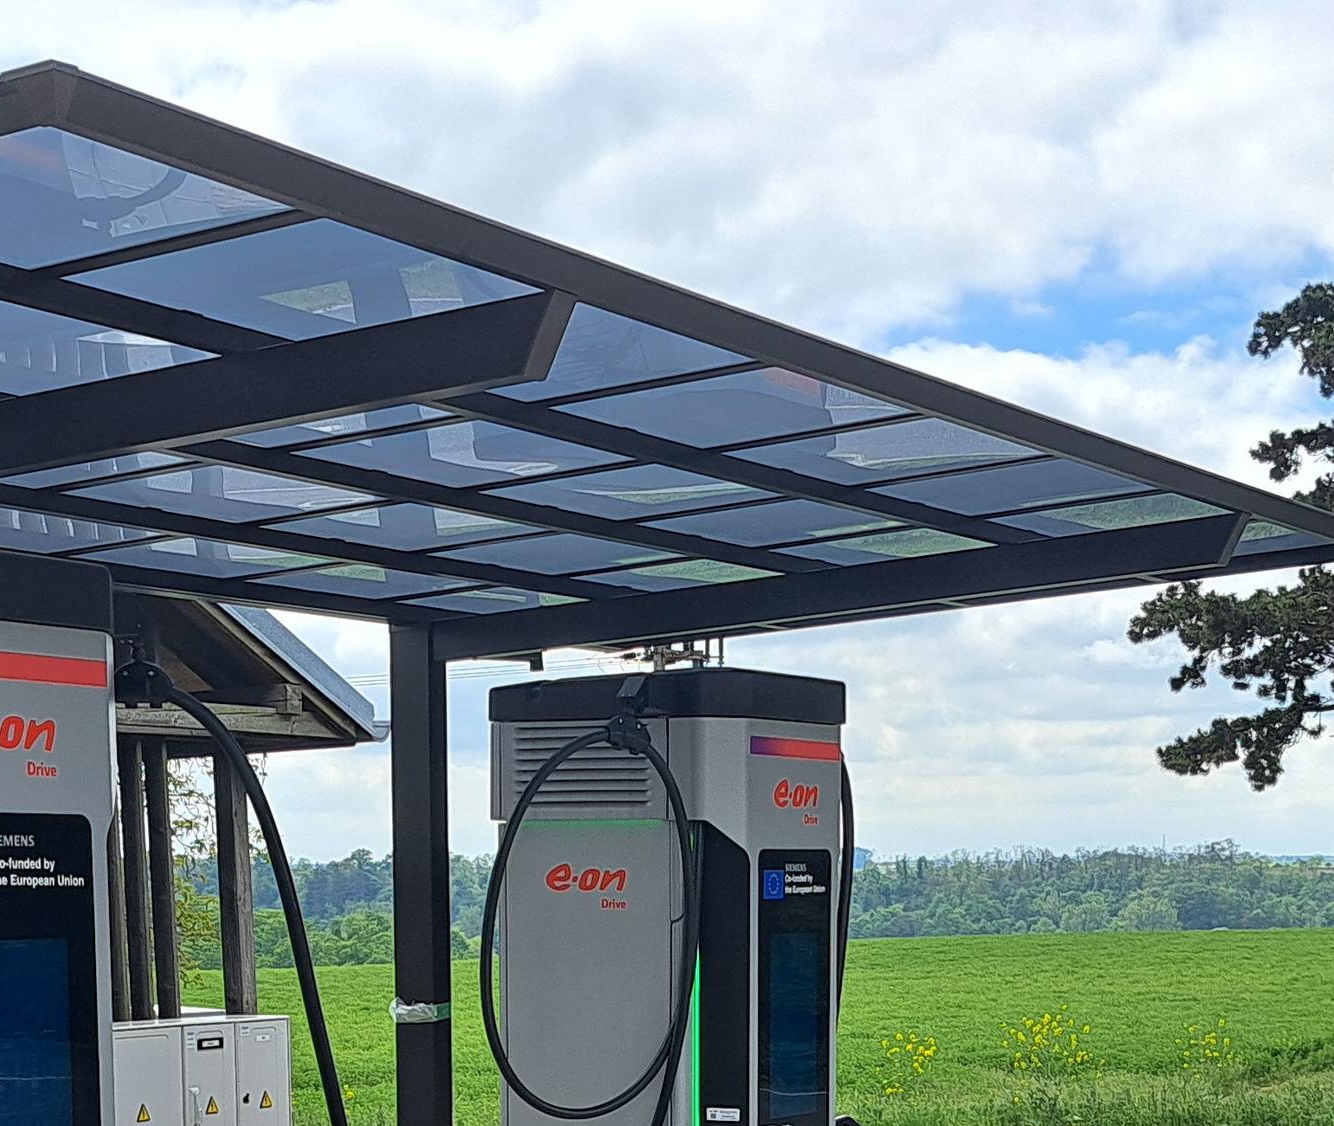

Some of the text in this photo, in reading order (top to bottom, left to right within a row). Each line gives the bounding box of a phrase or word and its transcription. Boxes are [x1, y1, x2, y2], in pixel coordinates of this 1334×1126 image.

[26, 760, 58, 778] Drive
[43, 857, 56, 873] by
[9, 873, 55, 889] European
[56, 873, 85, 887] Union
[600, 898, 627, 910] Drive
